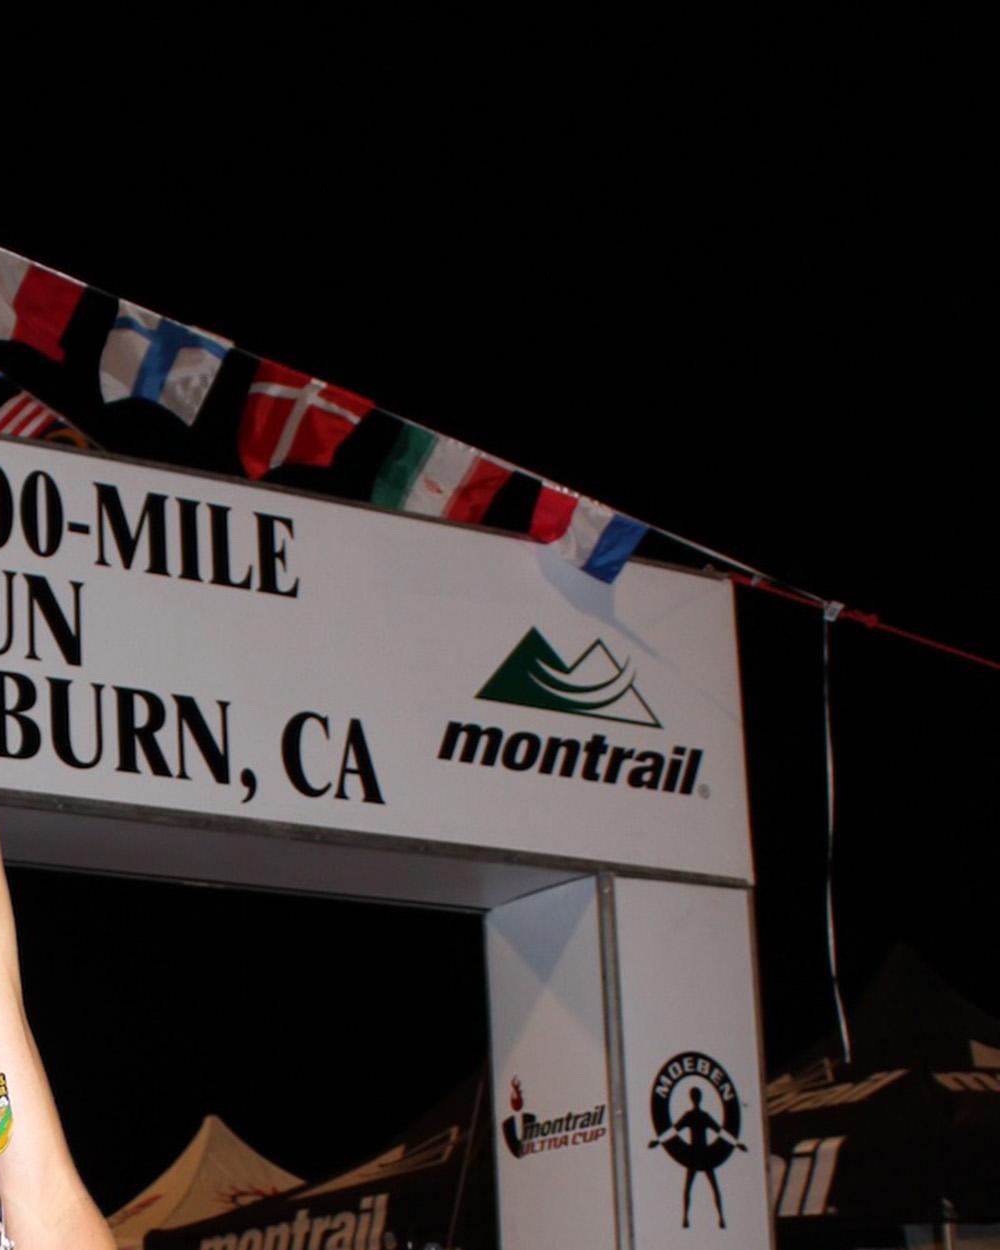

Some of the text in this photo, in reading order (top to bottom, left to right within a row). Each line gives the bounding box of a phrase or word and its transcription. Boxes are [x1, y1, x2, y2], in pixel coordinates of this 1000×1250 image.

[281, 711, 386, 805] CA
[437, 720, 704, 795] montrail
[655, 1056, 734, 1101] MOEBEN
[519, 1127, 606, 1156] ULTRA CUP
[521, 1104, 606, 1142] montrail
